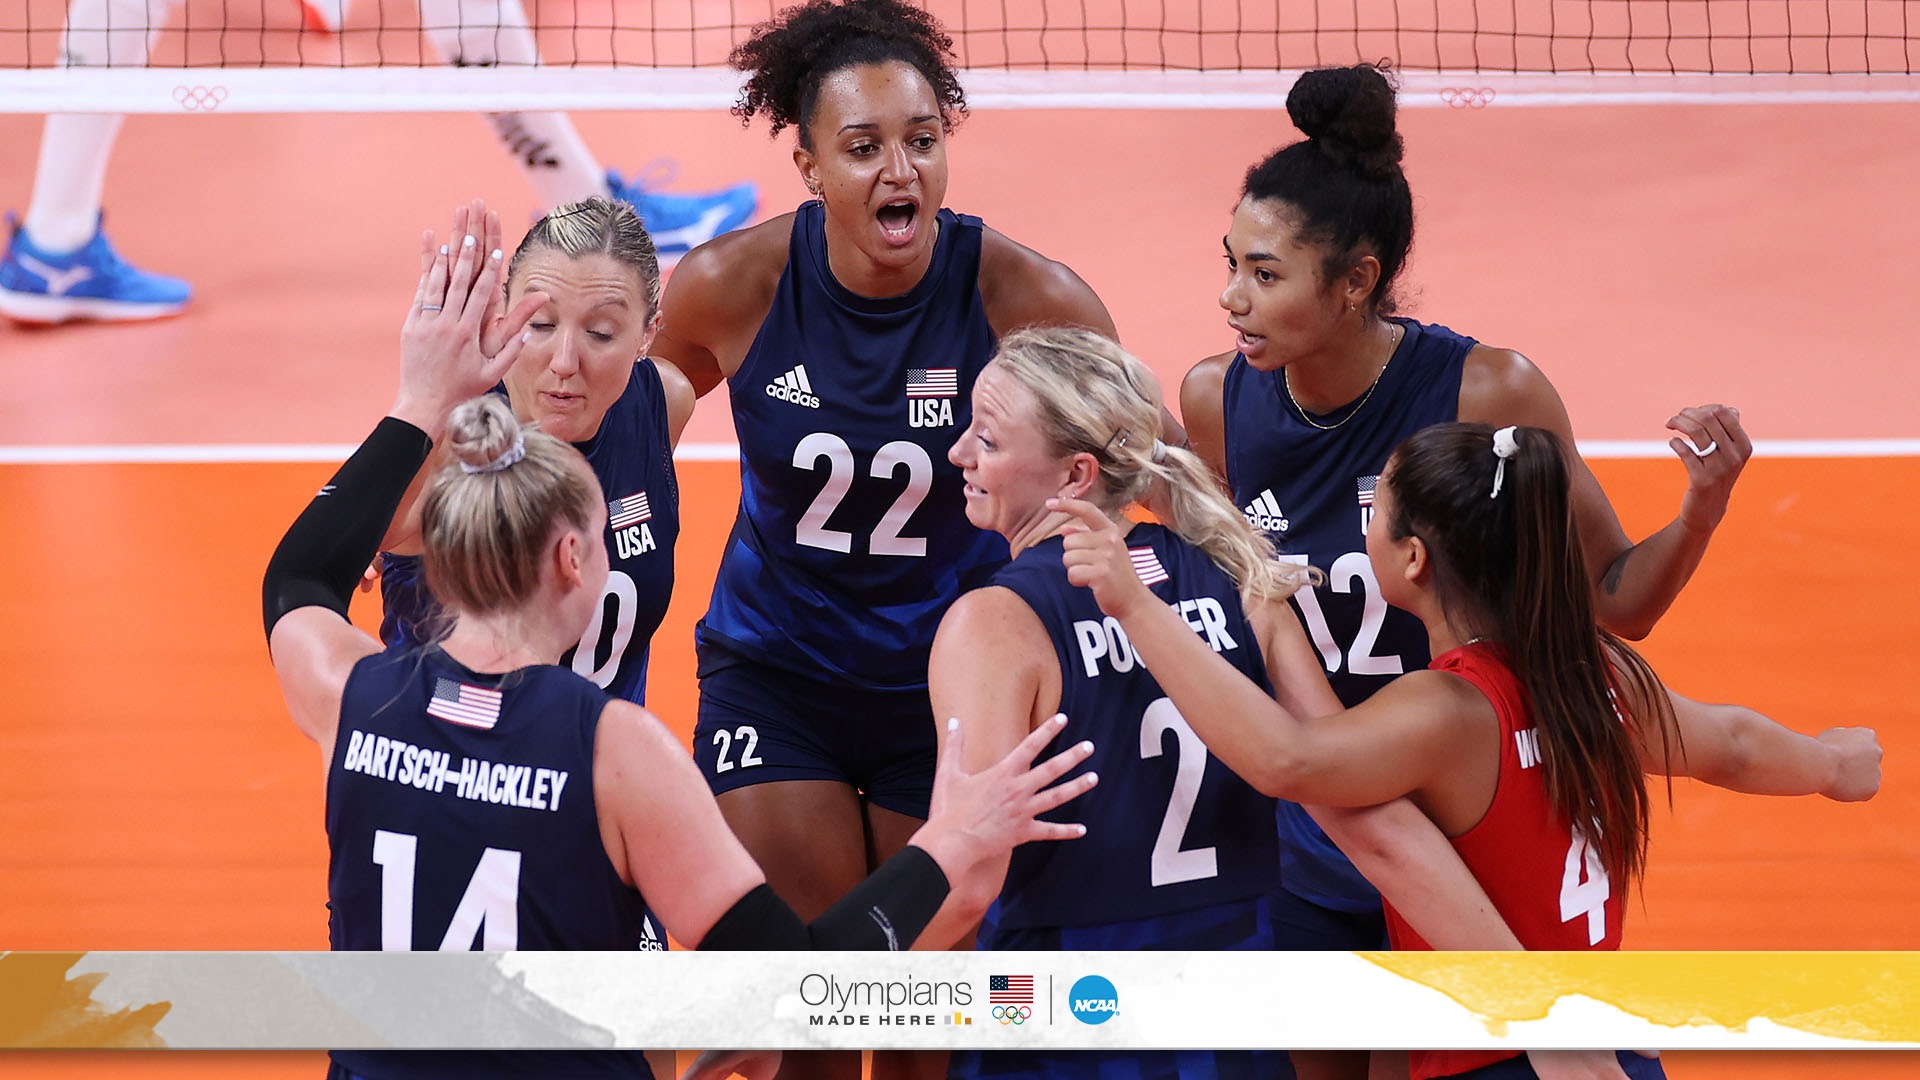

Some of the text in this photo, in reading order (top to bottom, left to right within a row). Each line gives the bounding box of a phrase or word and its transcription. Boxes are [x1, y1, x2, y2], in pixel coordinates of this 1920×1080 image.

[766, 384, 820, 409] adidas
[909, 399, 954, 428] USA
[792, 432, 933, 556] 22
[615, 522, 656, 560] USA
[1073, 597, 1239, 678] POER
[344, 730, 568, 812] BARTSCH-HACKLEY
[712, 726, 763, 774] 22
[1139, 696, 1218, 887] 2
[373, 830, 521, 951] 14
[1559, 814, 1610, 947] 4
